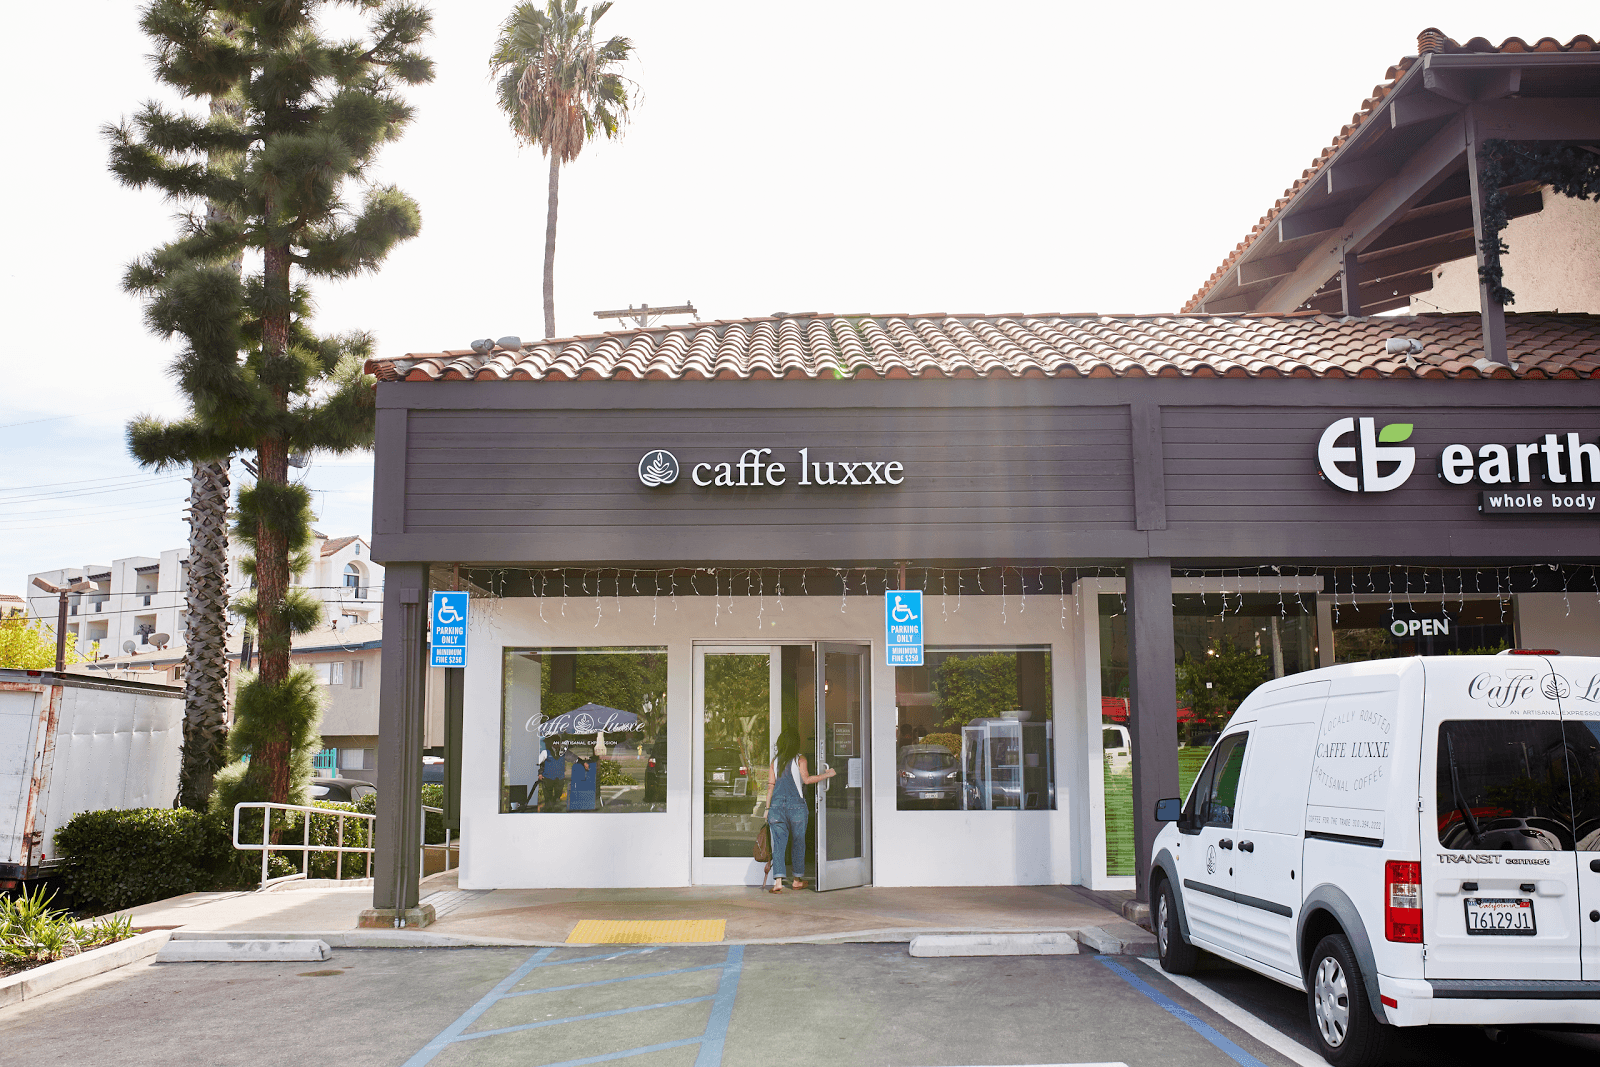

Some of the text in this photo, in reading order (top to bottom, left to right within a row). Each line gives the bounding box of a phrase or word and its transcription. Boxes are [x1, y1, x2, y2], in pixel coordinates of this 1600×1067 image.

[1441, 432, 1600, 485] earth
[691, 447, 905, 487] caffe luxxe
[1489, 493, 1596, 510] whole body
[436, 626, 464, 635] PARKING
[891, 625, 919, 634] PARKING
[1390, 618, 1450, 637] OPEN
[441, 635, 458, 644] ONLY
[896, 634, 914, 643] ONLY
[436, 648, 462, 656] MINIMUM
[892, 647, 918, 655] MINIMUM
[435, 656, 463, 664] FINE $250
[892, 654, 919, 662] FINE $250
[1468, 671, 1534, 709] Caffe
[525, 712, 646, 738] Caffe Luxxe
[1323, 709, 1391, 736] LOCALLY ROASTED
[1316, 741, 1390, 759] CAFFE LUXXE
[1314, 765, 1384, 792] ARTISANAL COFFEE
[1308, 814, 1321, 824] COFFEE
[1322, 816, 1330, 824] FOR
[1330, 816, 1338, 826] THE
[1339, 817, 1351, 827] TRADE
[1437, 853, 1551, 866] TRANSIT connect
[1478, 901, 1518, 911] California
[1470, 912, 1531, 929] 76129J1
